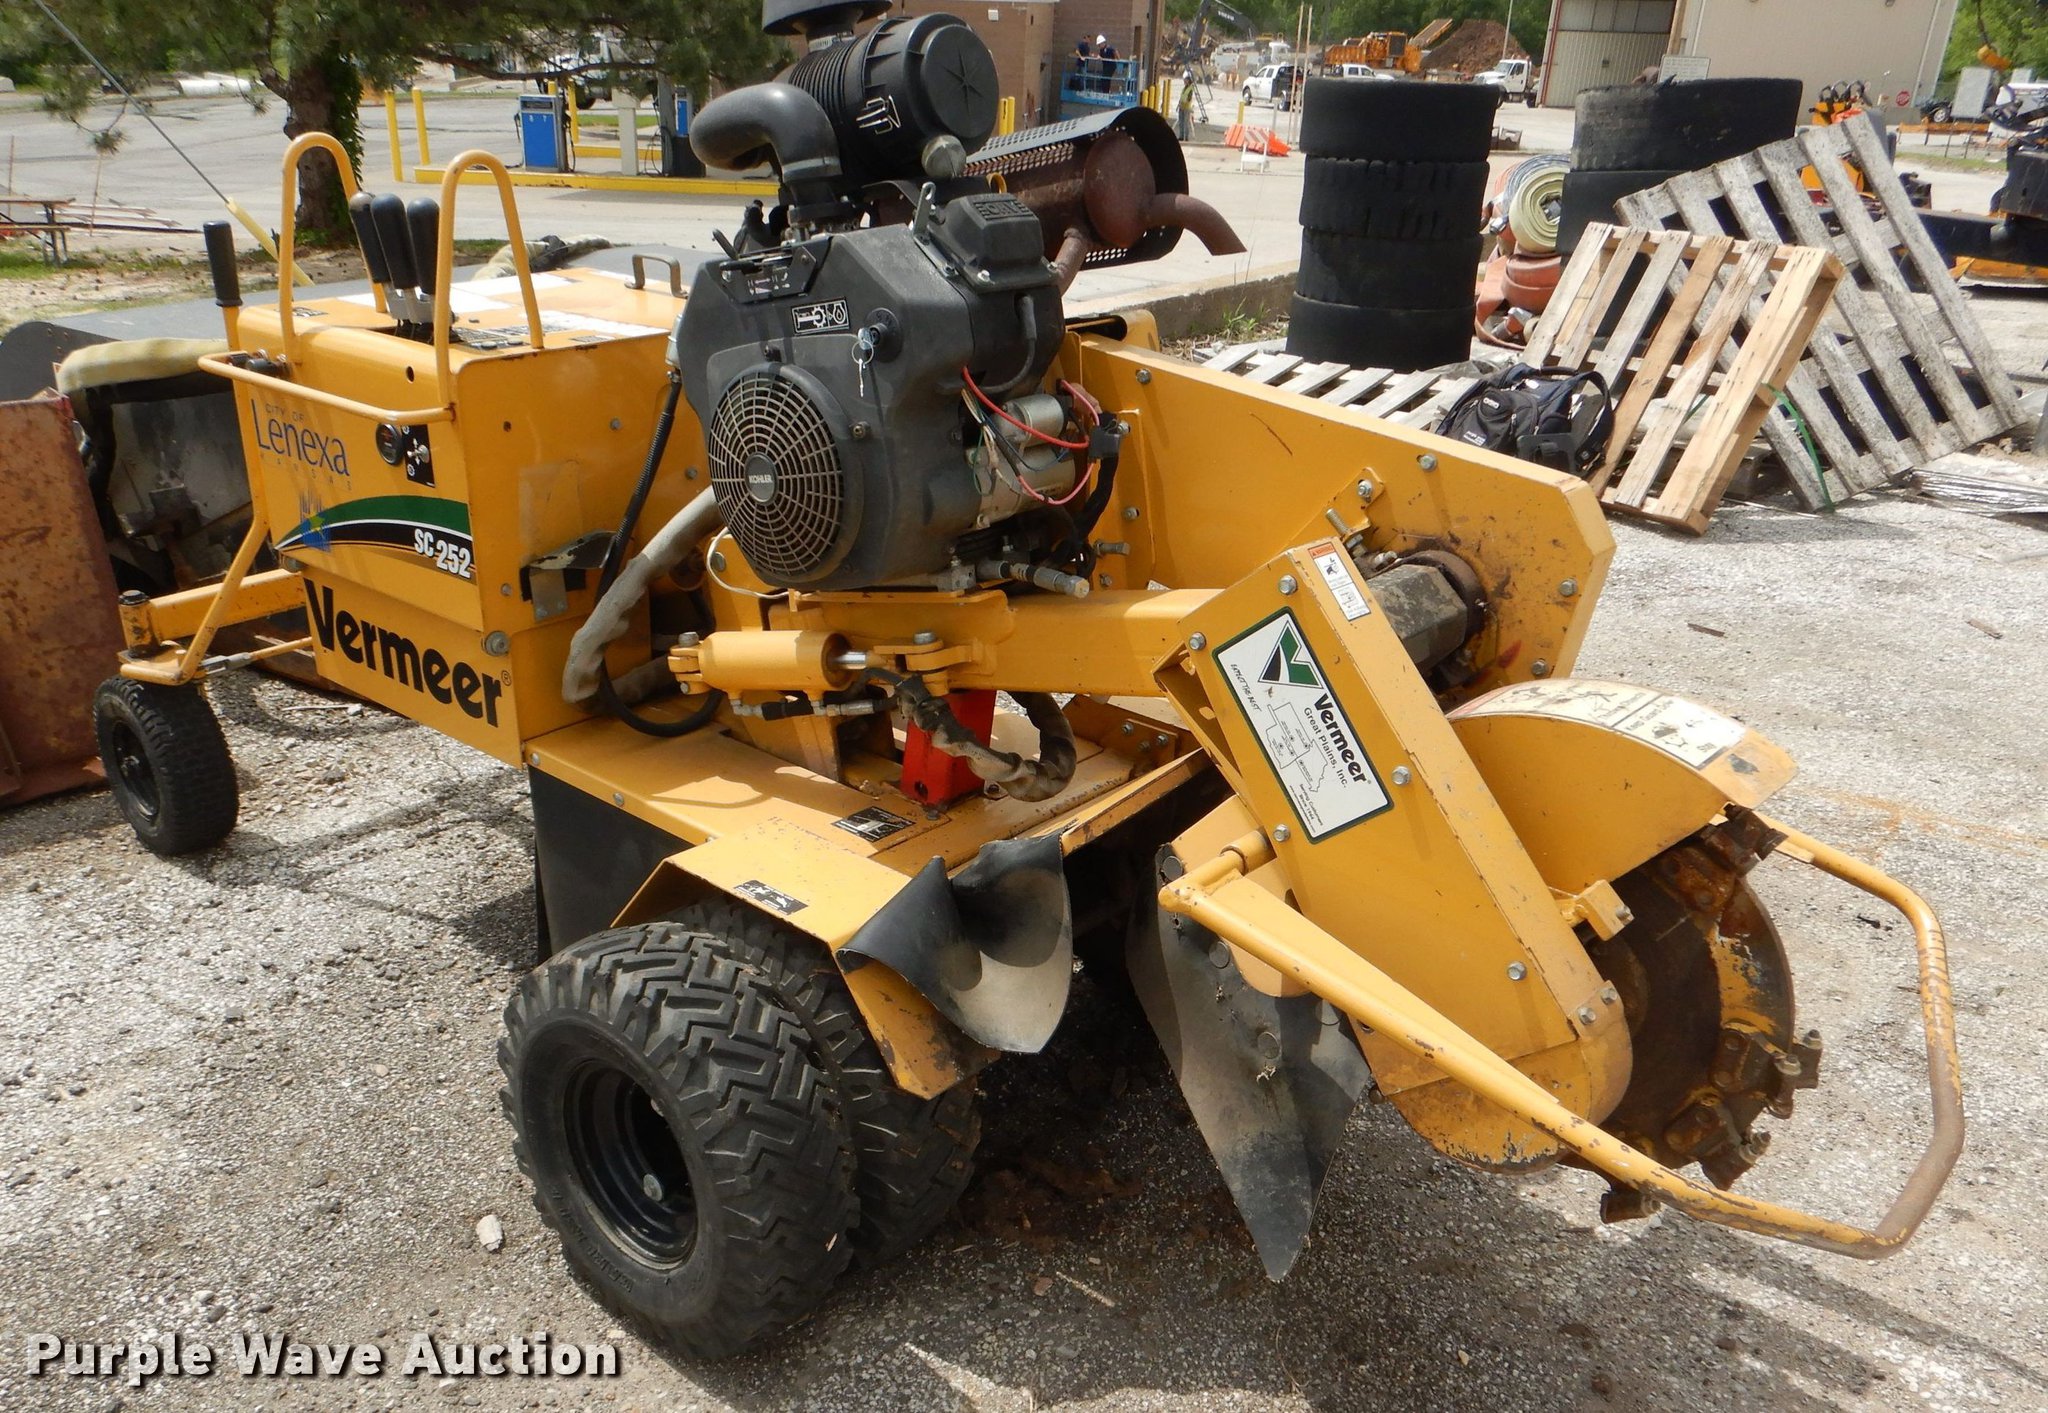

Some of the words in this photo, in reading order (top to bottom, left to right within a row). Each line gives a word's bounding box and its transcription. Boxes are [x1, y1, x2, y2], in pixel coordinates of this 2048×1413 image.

[251, 398, 350, 477] Lenexa
[264, 403, 286, 416] CITY
[291, 411, 305, 422] OF
[748, 474, 773, 484] KOHLER
[413, 527, 435, 557] SC
[436, 539, 472, 579] 252
[1304, 707, 1322, 735] Great
[1336, 769, 1348, 788] Inc.
[1314, 693, 1367, 783] Vermeer
